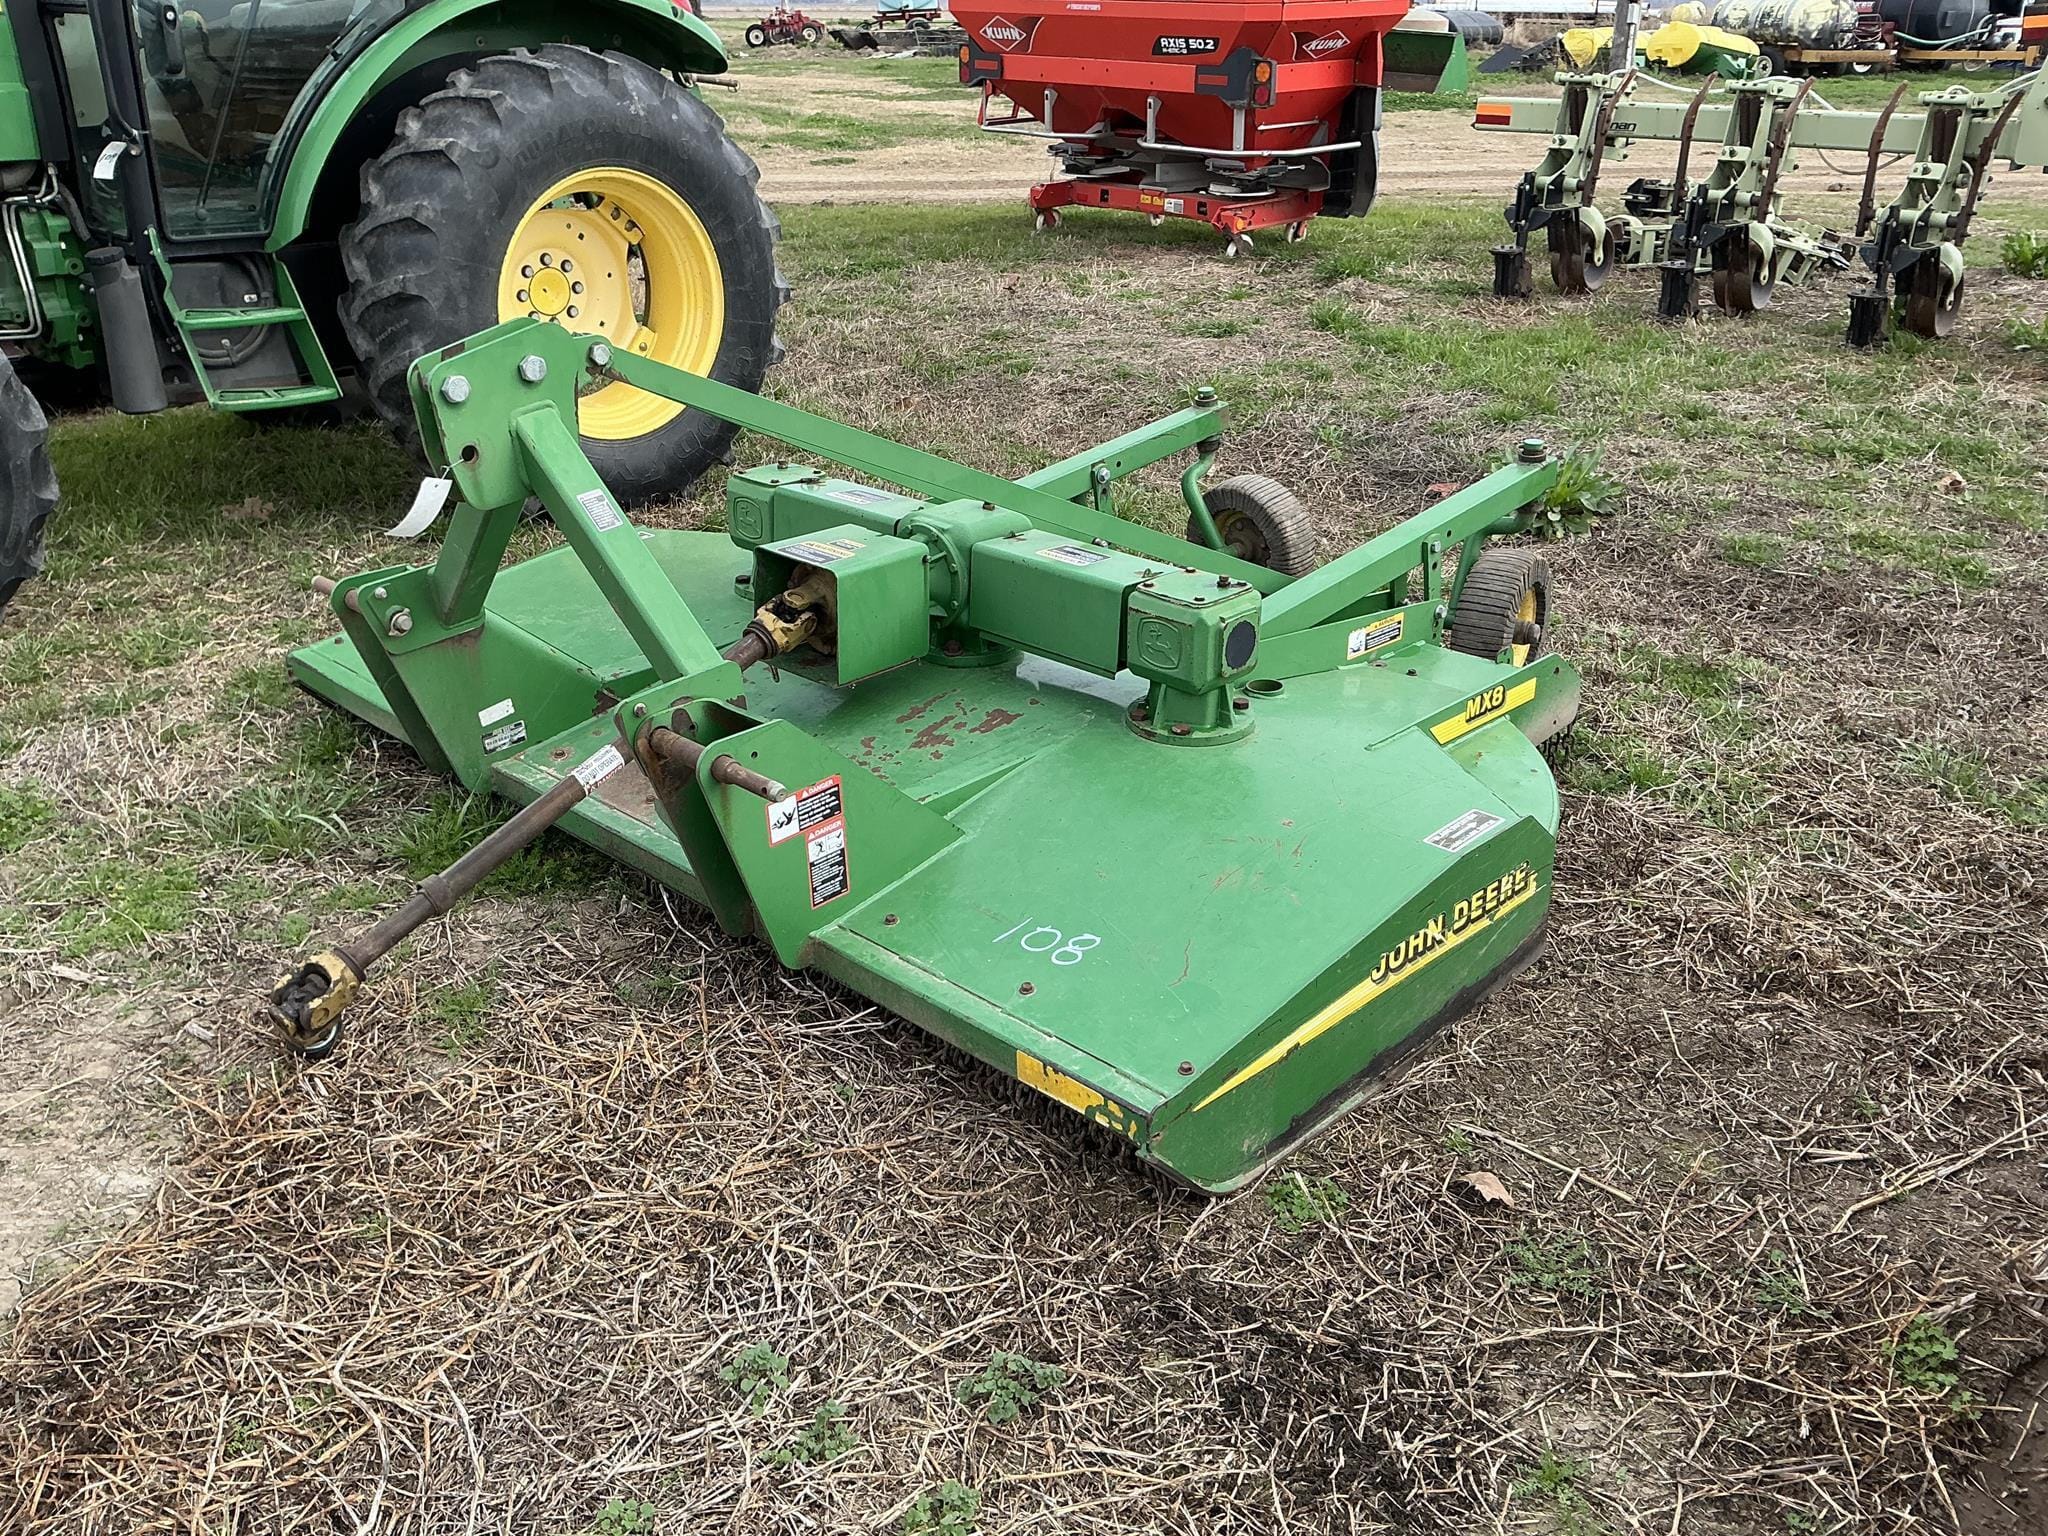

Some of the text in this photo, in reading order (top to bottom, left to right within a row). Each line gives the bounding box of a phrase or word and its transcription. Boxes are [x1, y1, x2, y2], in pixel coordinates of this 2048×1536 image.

[985, 26, 1020, 40] KUHN
[1160, 37, 1215, 50] AXIS 50.2
[1308, 38, 1346, 51] KUHN
[1465, 684, 1506, 723] MX8
[808, 779, 834, 794] DANGER
[814, 821, 842, 835] DANGER
[1370, 859, 1532, 985] JOHN DEERE
[991, 916, 1102, 965] 108
